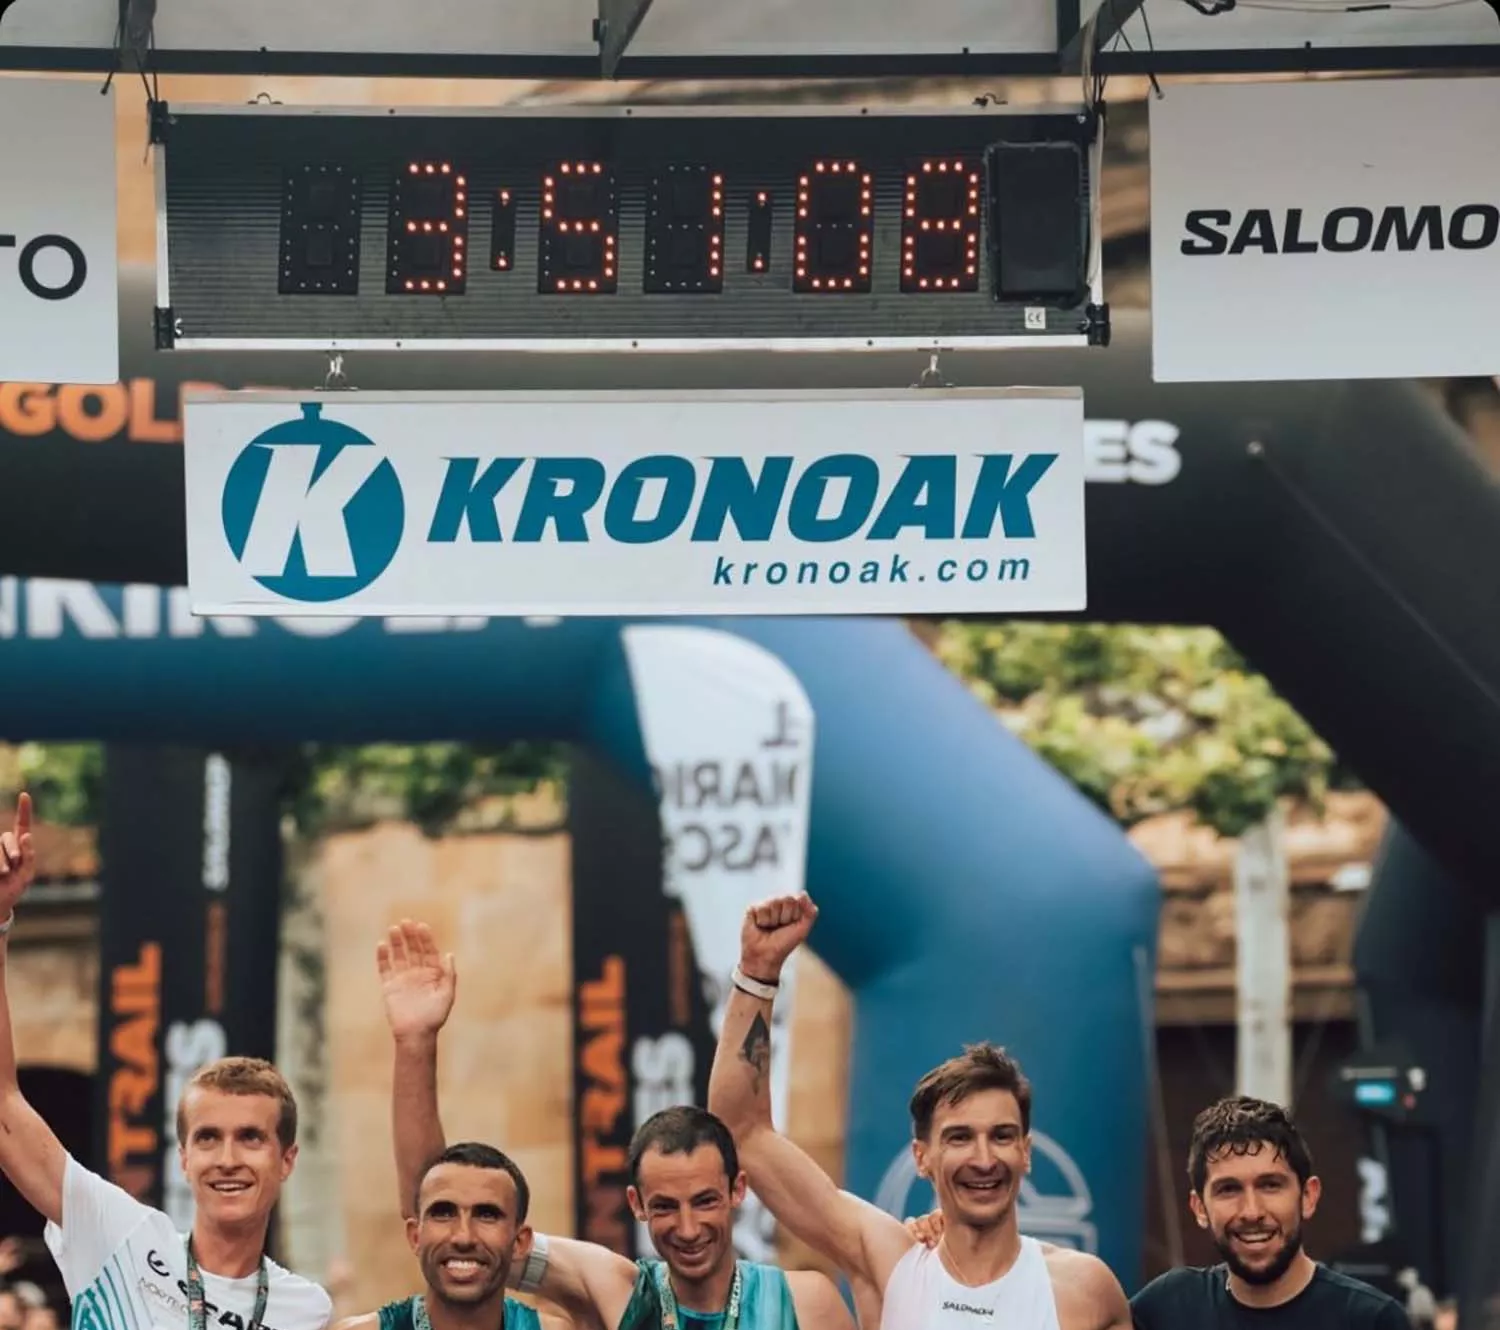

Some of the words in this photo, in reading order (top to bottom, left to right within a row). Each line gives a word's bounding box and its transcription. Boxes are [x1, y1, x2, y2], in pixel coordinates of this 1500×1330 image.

[1180, 203, 1499, 256] SALOMO
[0, 379, 186, 442] GOL
[426, 452, 1059, 545] KRONOAK
[712, 553, 1031, 586] kronoak.com
[942, 1300, 995, 1317] SALOMON
